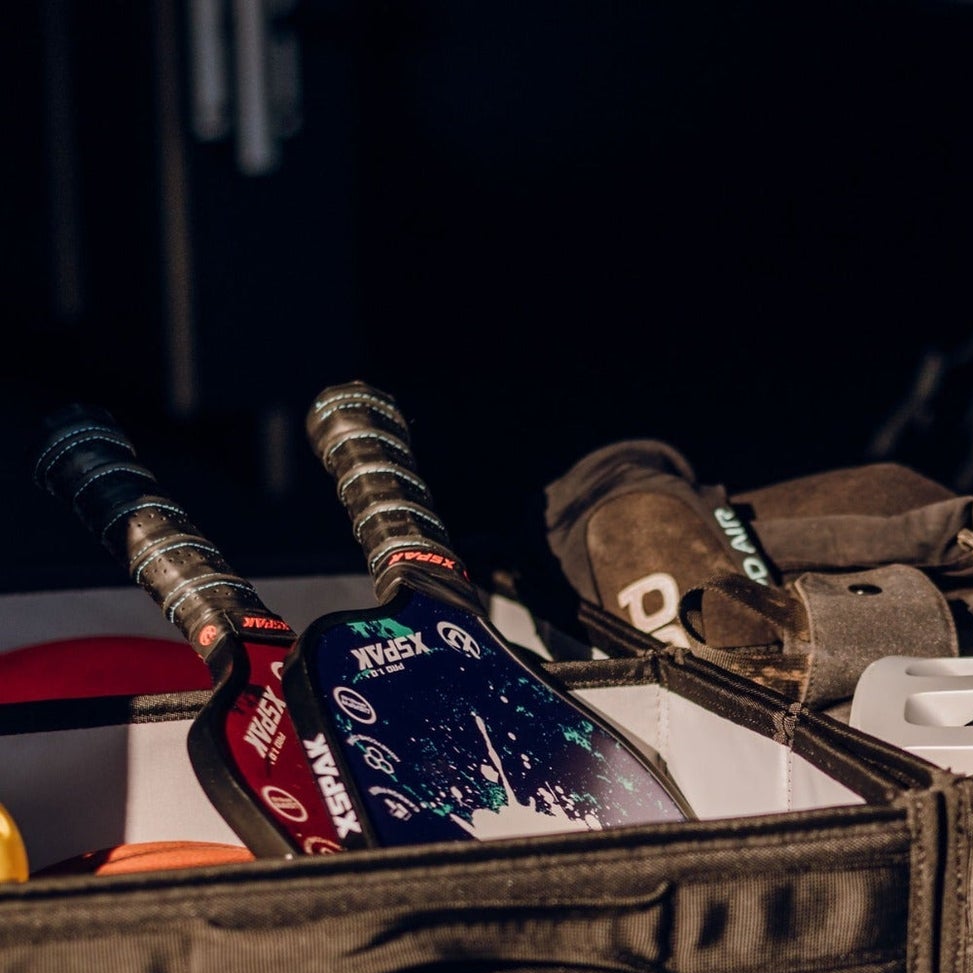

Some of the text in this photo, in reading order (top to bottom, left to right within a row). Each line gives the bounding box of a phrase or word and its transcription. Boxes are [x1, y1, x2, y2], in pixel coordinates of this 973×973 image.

[714, 506, 757, 555] AIR
[388, 551, 456, 570] XSPAK
[350, 632, 431, 671] XSPAK
[385, 662, 405, 674] PRO
[243, 685, 287, 759] XSPAK
[302, 732, 363, 840] XSPAK
